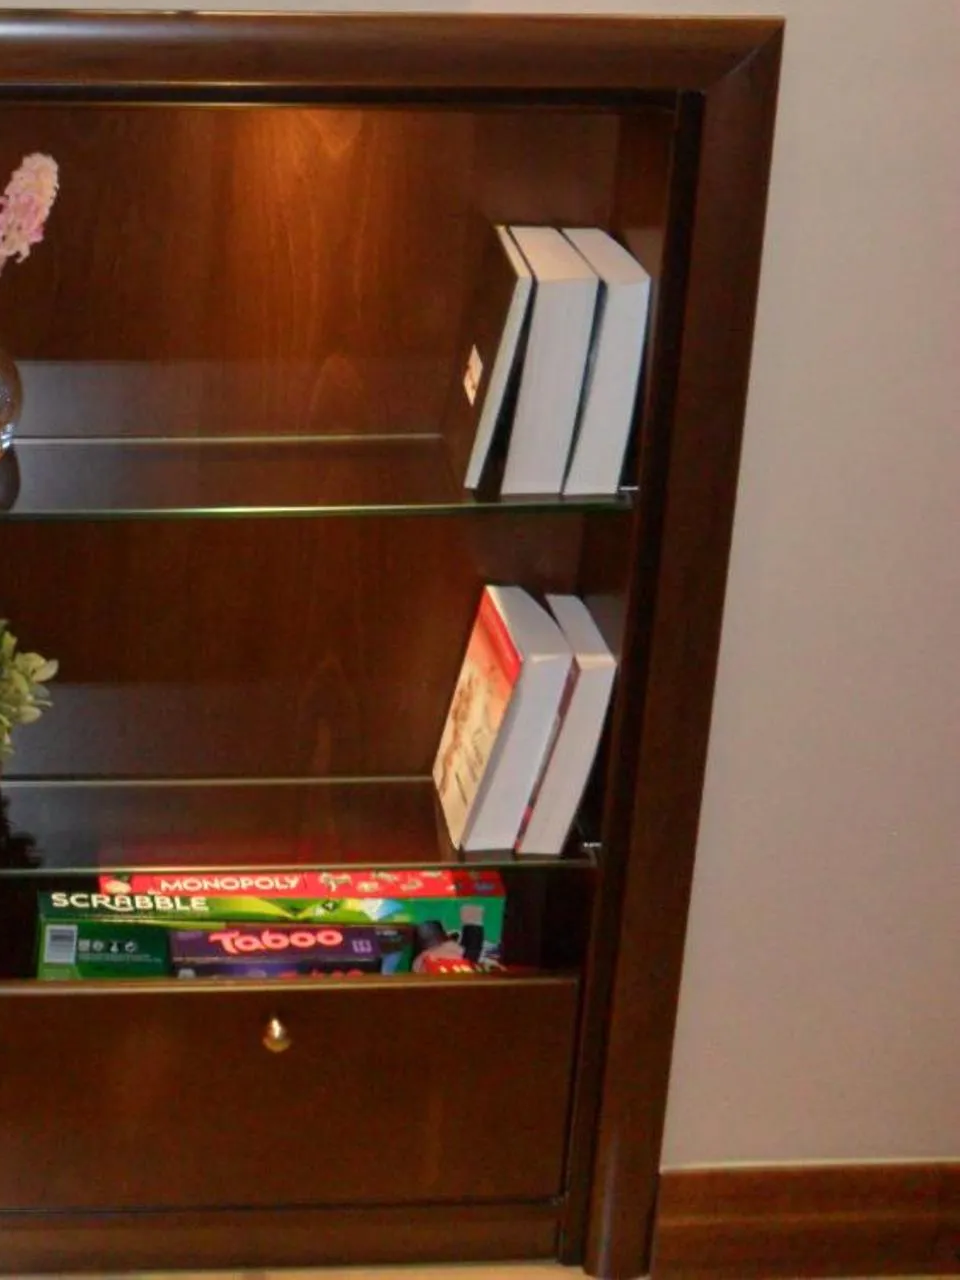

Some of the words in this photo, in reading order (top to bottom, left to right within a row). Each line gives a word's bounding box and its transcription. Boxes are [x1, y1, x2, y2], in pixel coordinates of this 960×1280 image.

[160, 876, 300, 892] MONOPOLY
[50, 892, 210, 912] SCRABBLE
[208, 929, 344, 955] Taboo
